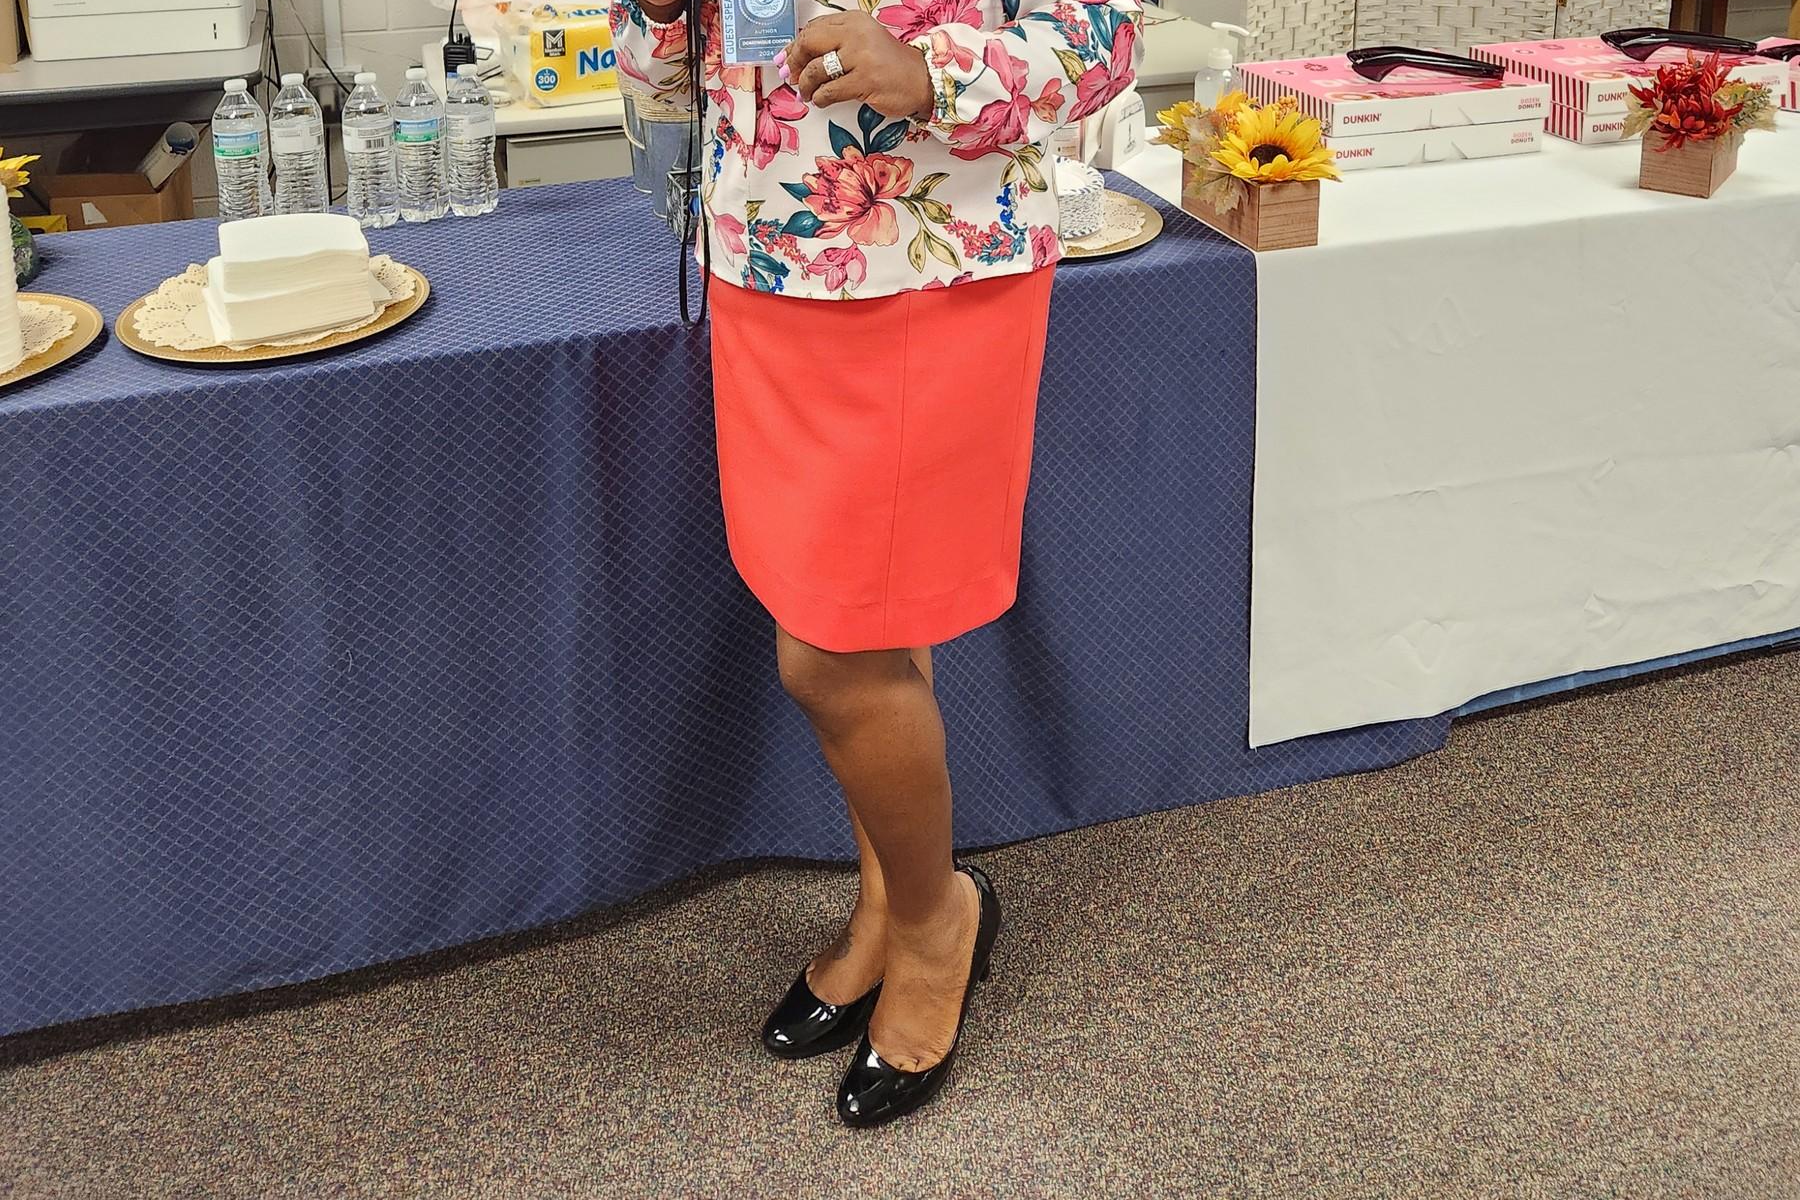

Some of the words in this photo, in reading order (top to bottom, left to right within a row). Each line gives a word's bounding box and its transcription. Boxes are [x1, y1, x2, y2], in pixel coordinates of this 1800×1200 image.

[725, 23, 735, 54] GUEST
[538, 75, 556, 84] 300
[1343, 113, 1382, 125] DUNKIN'
[1336, 148, 1375, 160] DUNKIN'
